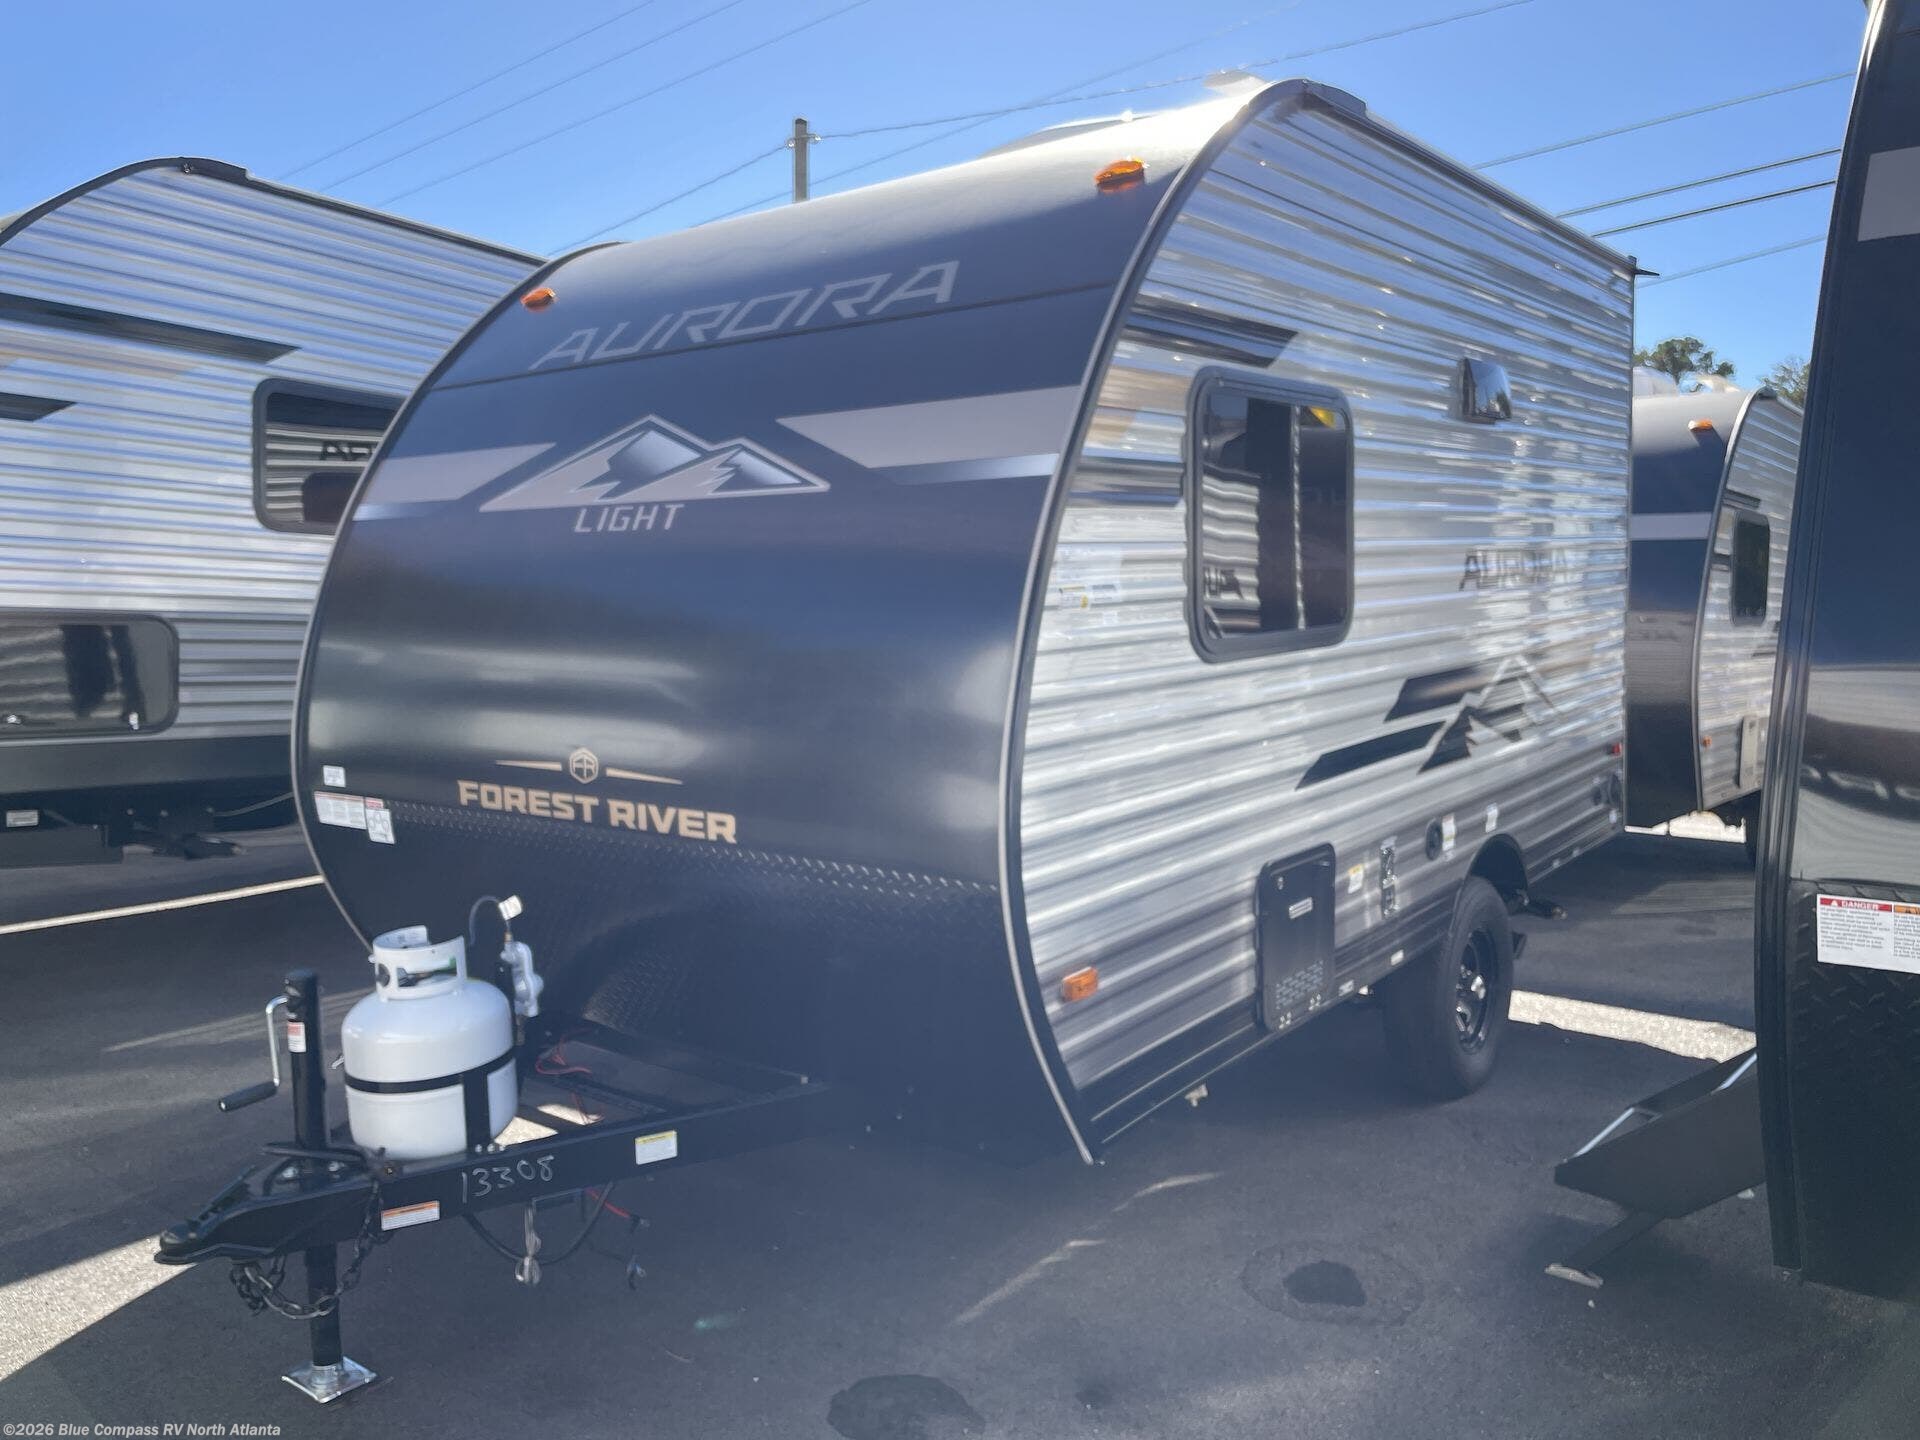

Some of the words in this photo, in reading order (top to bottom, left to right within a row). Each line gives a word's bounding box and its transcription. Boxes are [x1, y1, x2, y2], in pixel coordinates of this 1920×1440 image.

[529, 260, 960, 371] AURORA
[574, 503, 684, 533] LIGHT
[457, 780, 599, 823] FOREST
[606, 799, 737, 844] RIVER
[1841, 900, 1879, 910] DANGER
[461, 1155, 555, 1204] 13308
